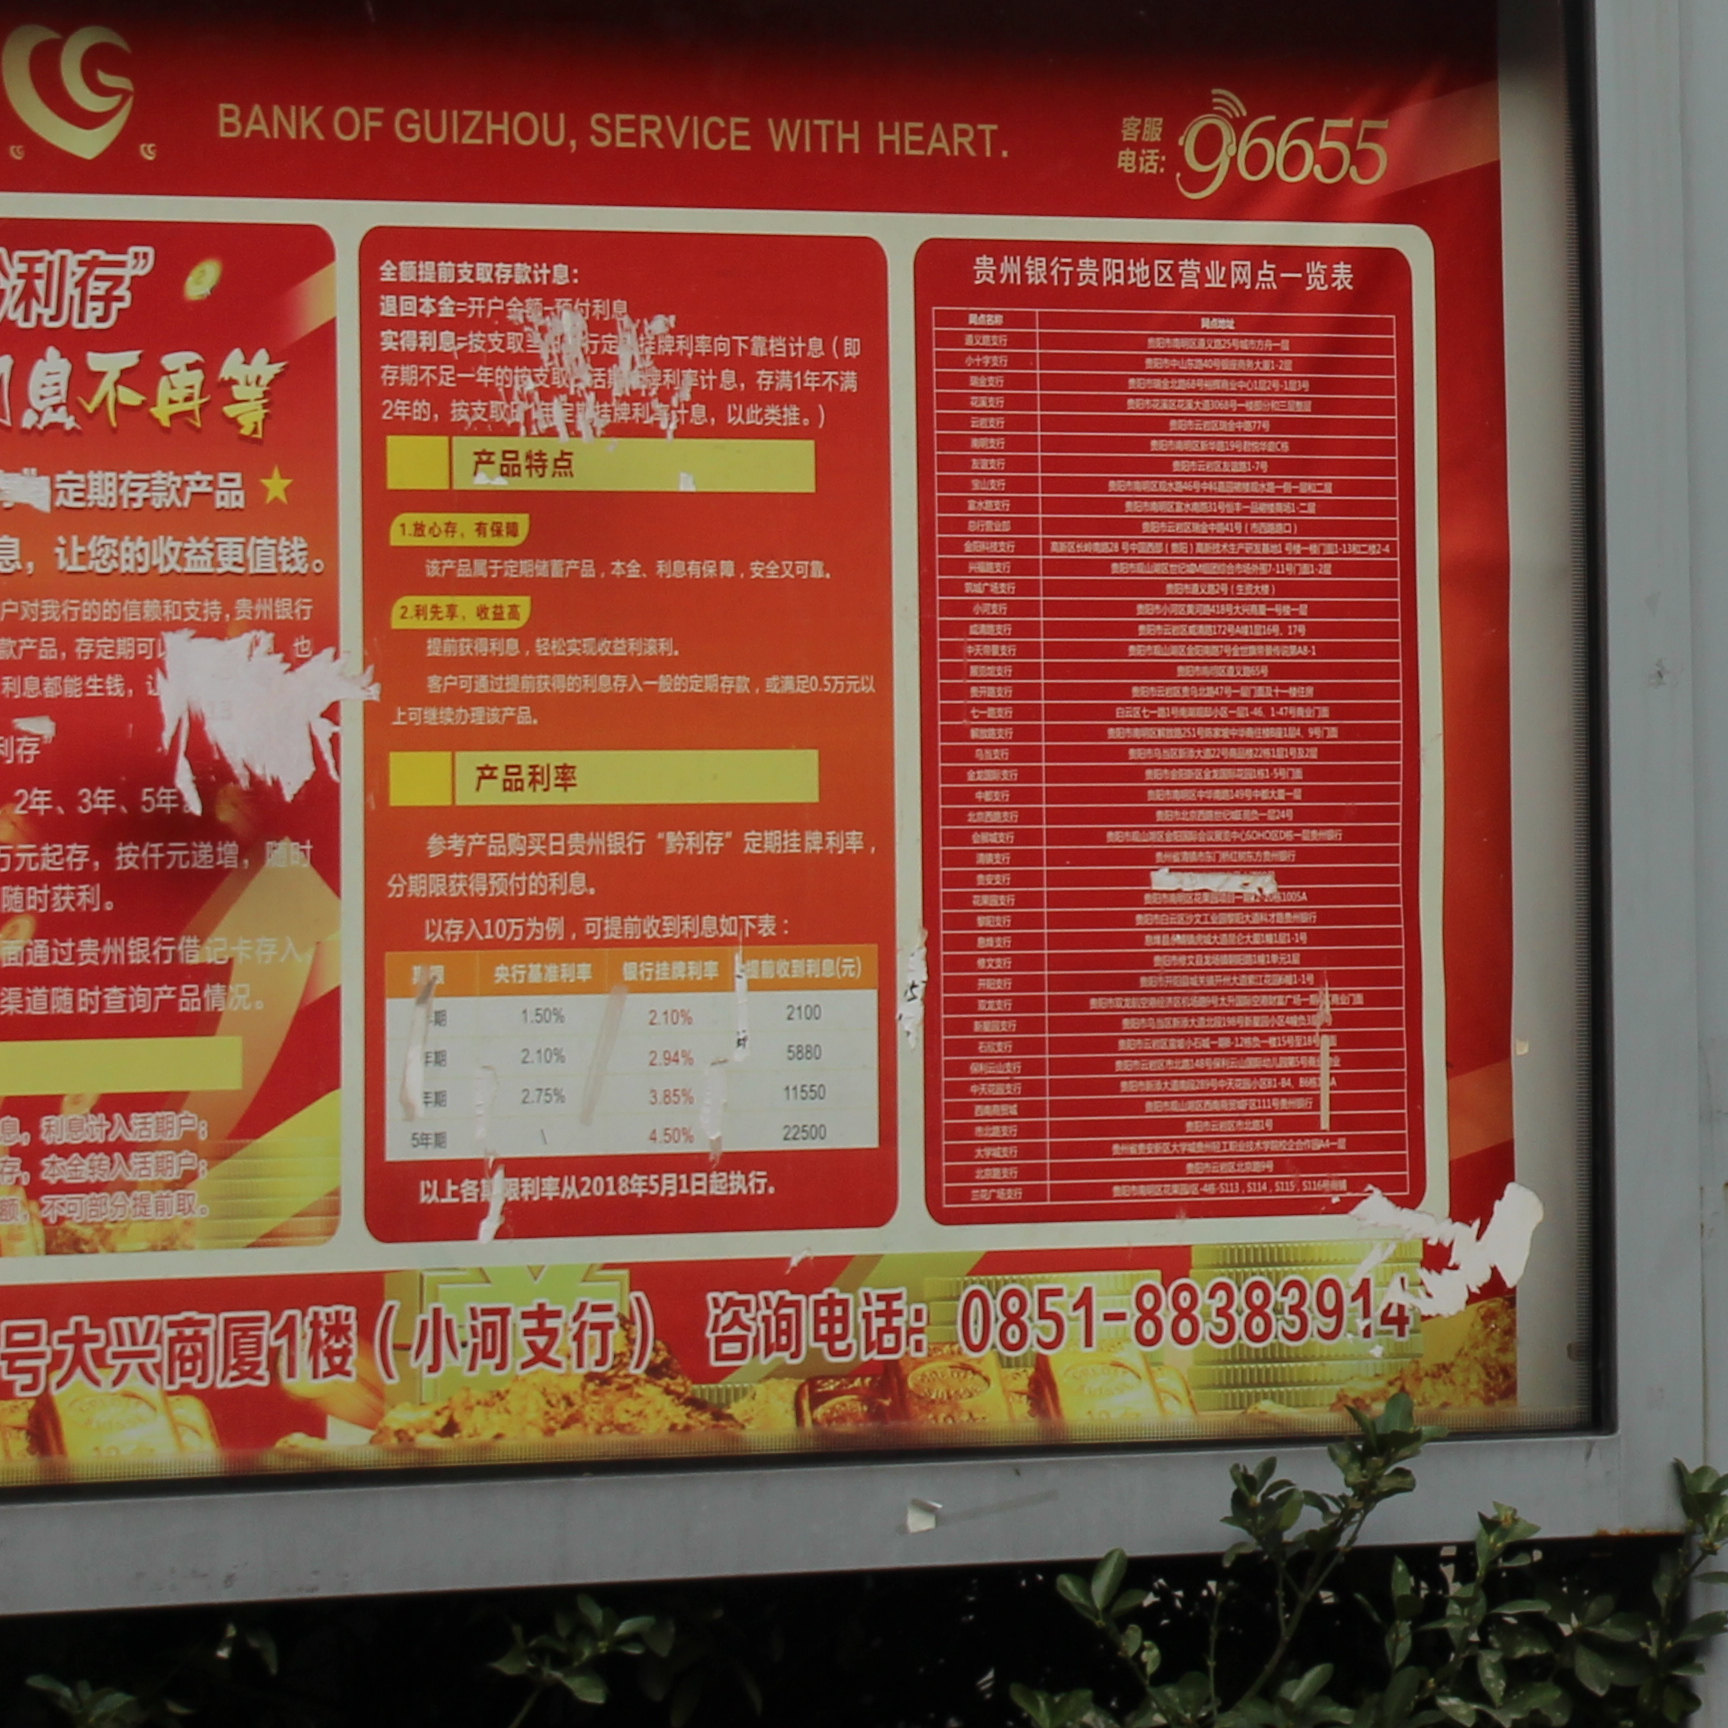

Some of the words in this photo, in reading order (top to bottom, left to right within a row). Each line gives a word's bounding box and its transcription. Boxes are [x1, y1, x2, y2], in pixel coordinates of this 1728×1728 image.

[217, 102, 325, 141] BANK
[332, 106, 385, 143] OF
[394, 108, 579, 155] GUIZHOU,
[588, 114, 751, 153] SERVICE
[766, 118, 861, 156] WITH
[876, 121, 1011, 160] HEART.
[1121, 115, 1164, 143] 客服
[1175, 114, 1390, 200] 96655
[972, 253, 1354, 292] 贵州银行贵阳地区营业网点一览表
[0, 345, 289, 442] 息不再等
[472, 448, 576, 479] 产品特点
[475, 763, 578, 793] 产品利率
[493, 961, 594, 985] 央行基准利率
[622, 959, 720, 983] 银行挂牌利率
[520, 1006, 567, 1026] 1.50%
[647, 1008, 694, 1027] 2.10%
[785, 1003, 823, 1022] 2100
[520, 1046, 567, 1066] 2.10%
[647, 1048, 695, 1067] 2.94%
[786, 1043, 823, 1062] 5880
[520, 1086, 567, 1106] 2.75%
[648, 1087, 695, 1107] 3.85%
[782, 1083, 827, 1102] 11550
[410, 1130, 448, 1149] 5年期
[647, 1126, 695, 1145] 4.50%
[782, 1123, 828, 1142] 22500
[957, 1274, 1414, 1357] 0851-88383914
